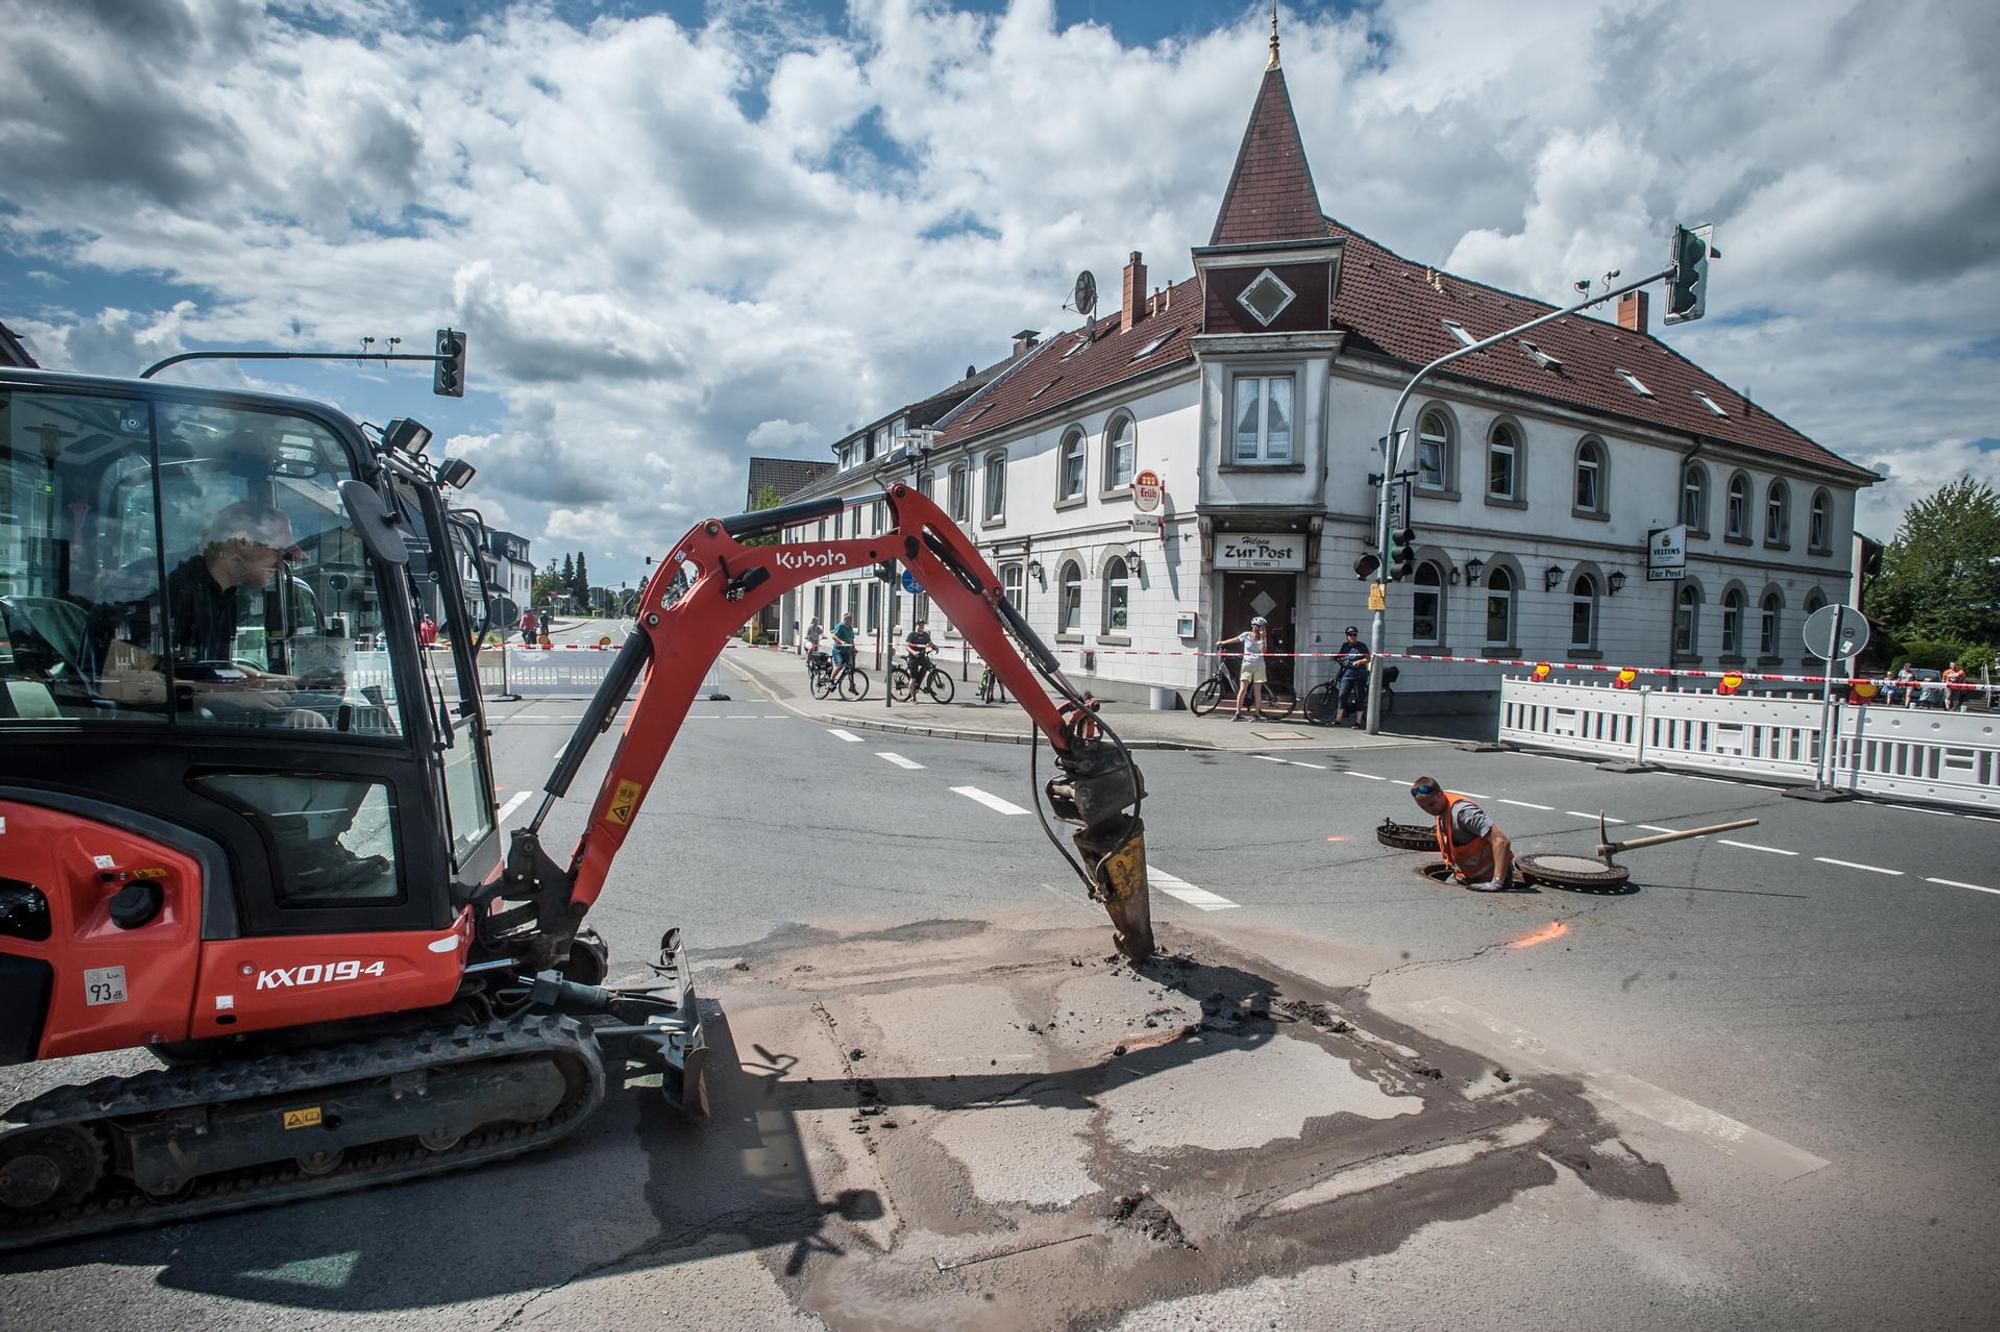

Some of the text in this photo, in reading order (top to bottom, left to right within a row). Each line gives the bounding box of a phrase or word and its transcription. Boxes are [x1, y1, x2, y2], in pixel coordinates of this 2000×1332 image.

[776, 549, 847, 569] Kubota
[1224, 545, 1293, 559] Zur Post
[256, 960, 385, 990] KX019-4
[90, 983, 112, 1002] 93
